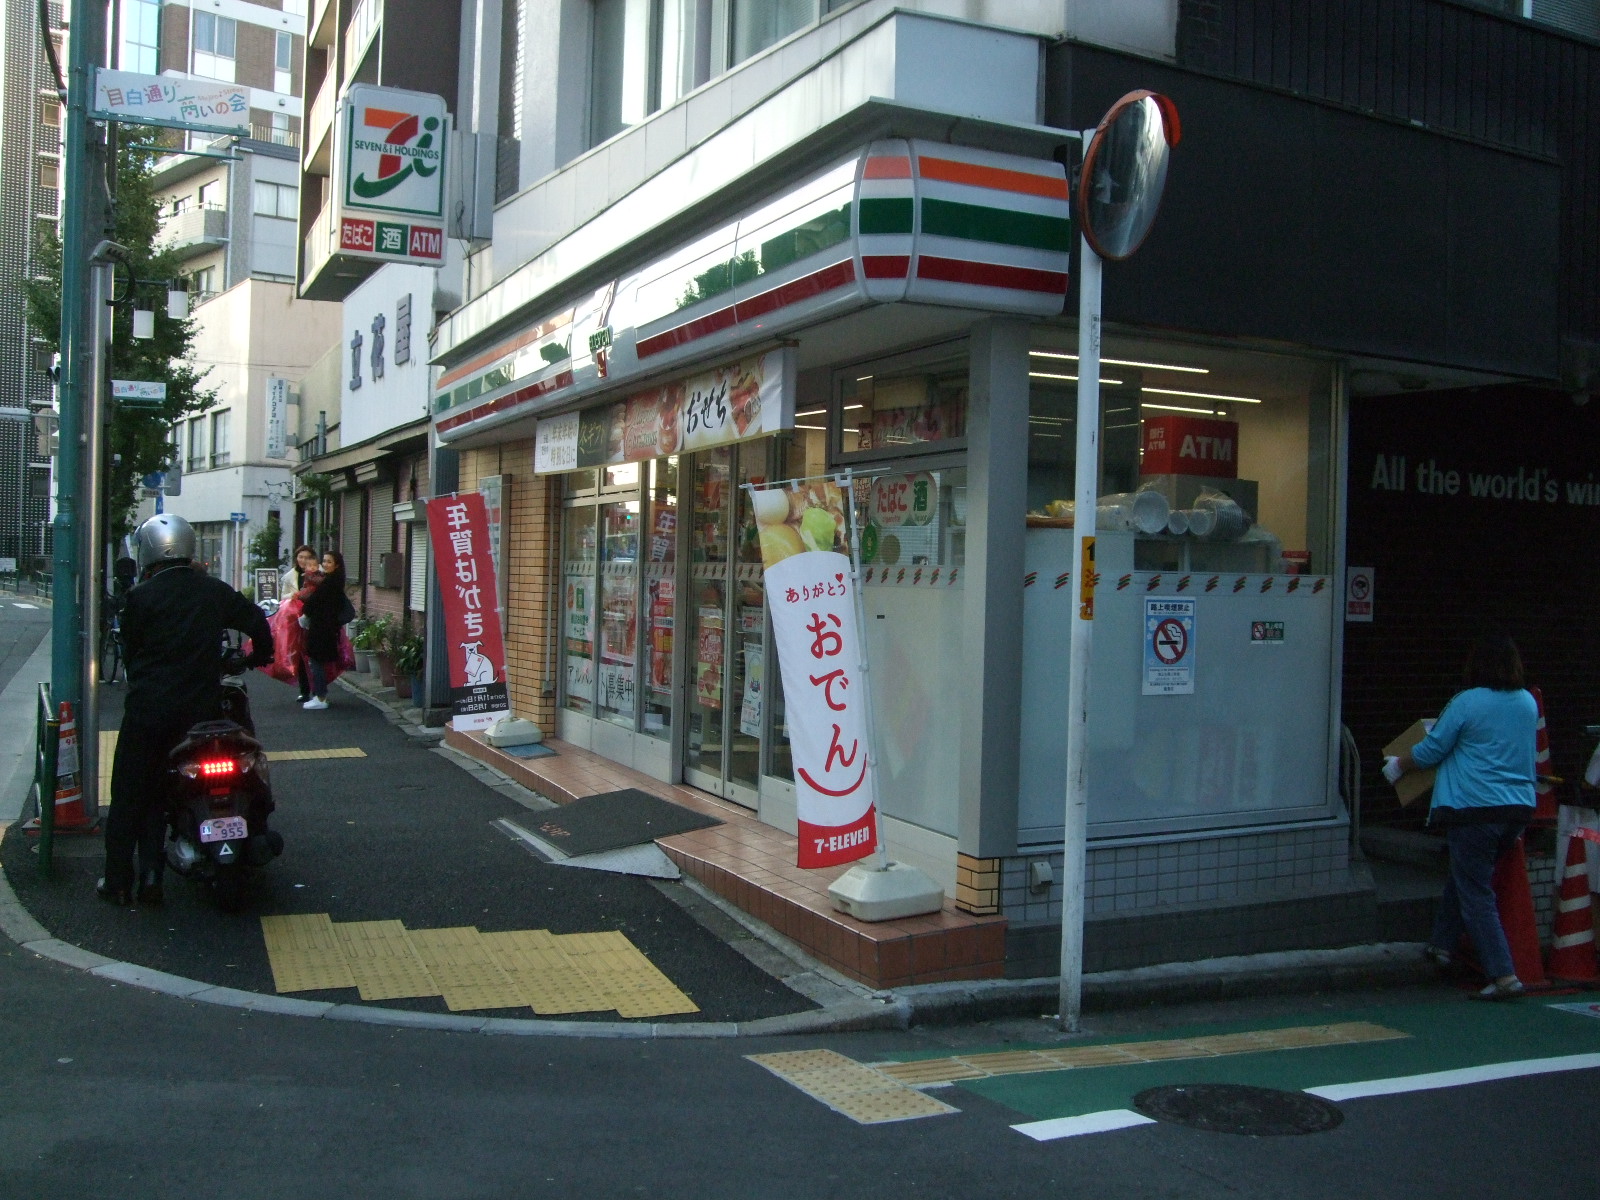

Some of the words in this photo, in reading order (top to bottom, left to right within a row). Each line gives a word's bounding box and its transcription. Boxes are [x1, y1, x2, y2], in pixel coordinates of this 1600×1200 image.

[107, 84, 176, 107] 目白通り
[394, 146, 440, 160] HOLDINGS
[342, 222, 373, 246] たばこ
[381, 227, 403, 250] 酒
[411, 231, 440, 254] ATM
[687, 379, 727, 434] おせち
[1148, 440, 1166, 450] ATM
[1179, 434, 1232, 461] ATM
[1371, 453, 1405, 491] All
[1416, 458, 1461, 496] the
[1468, 465, 1559, 503] world's
[1566, 472, 1600, 505] wi
[877, 483, 907, 513] たばこ
[913, 480, 928, 511] 酒
[785, 581, 846, 603] ありがとう
[806, 612, 857, 773] おでん
[221, 827, 244, 838] 955
